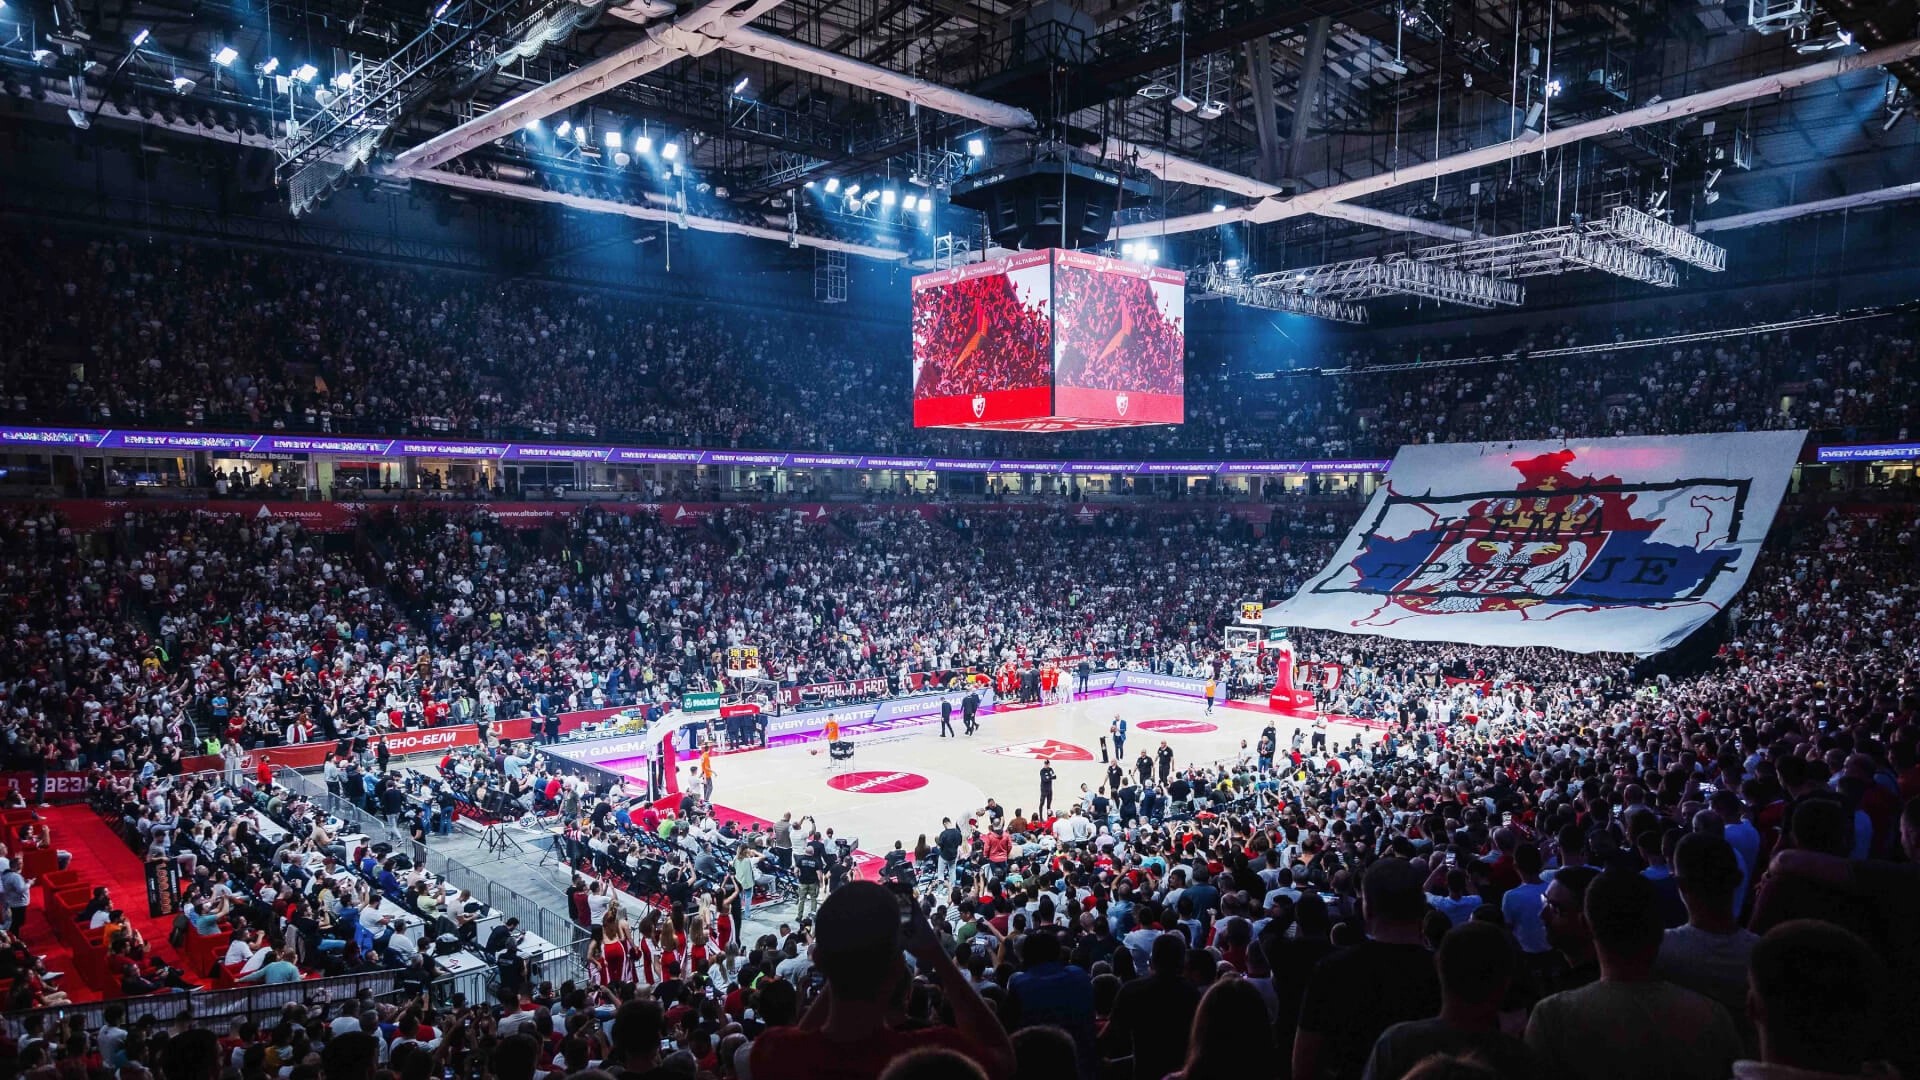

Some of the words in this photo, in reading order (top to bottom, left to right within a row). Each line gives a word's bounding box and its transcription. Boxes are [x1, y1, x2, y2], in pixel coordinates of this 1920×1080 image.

[1127, 676, 1153, 687] EVERY
[892, 703, 920, 714] EVERY
[771, 719, 804, 731] EVERY
